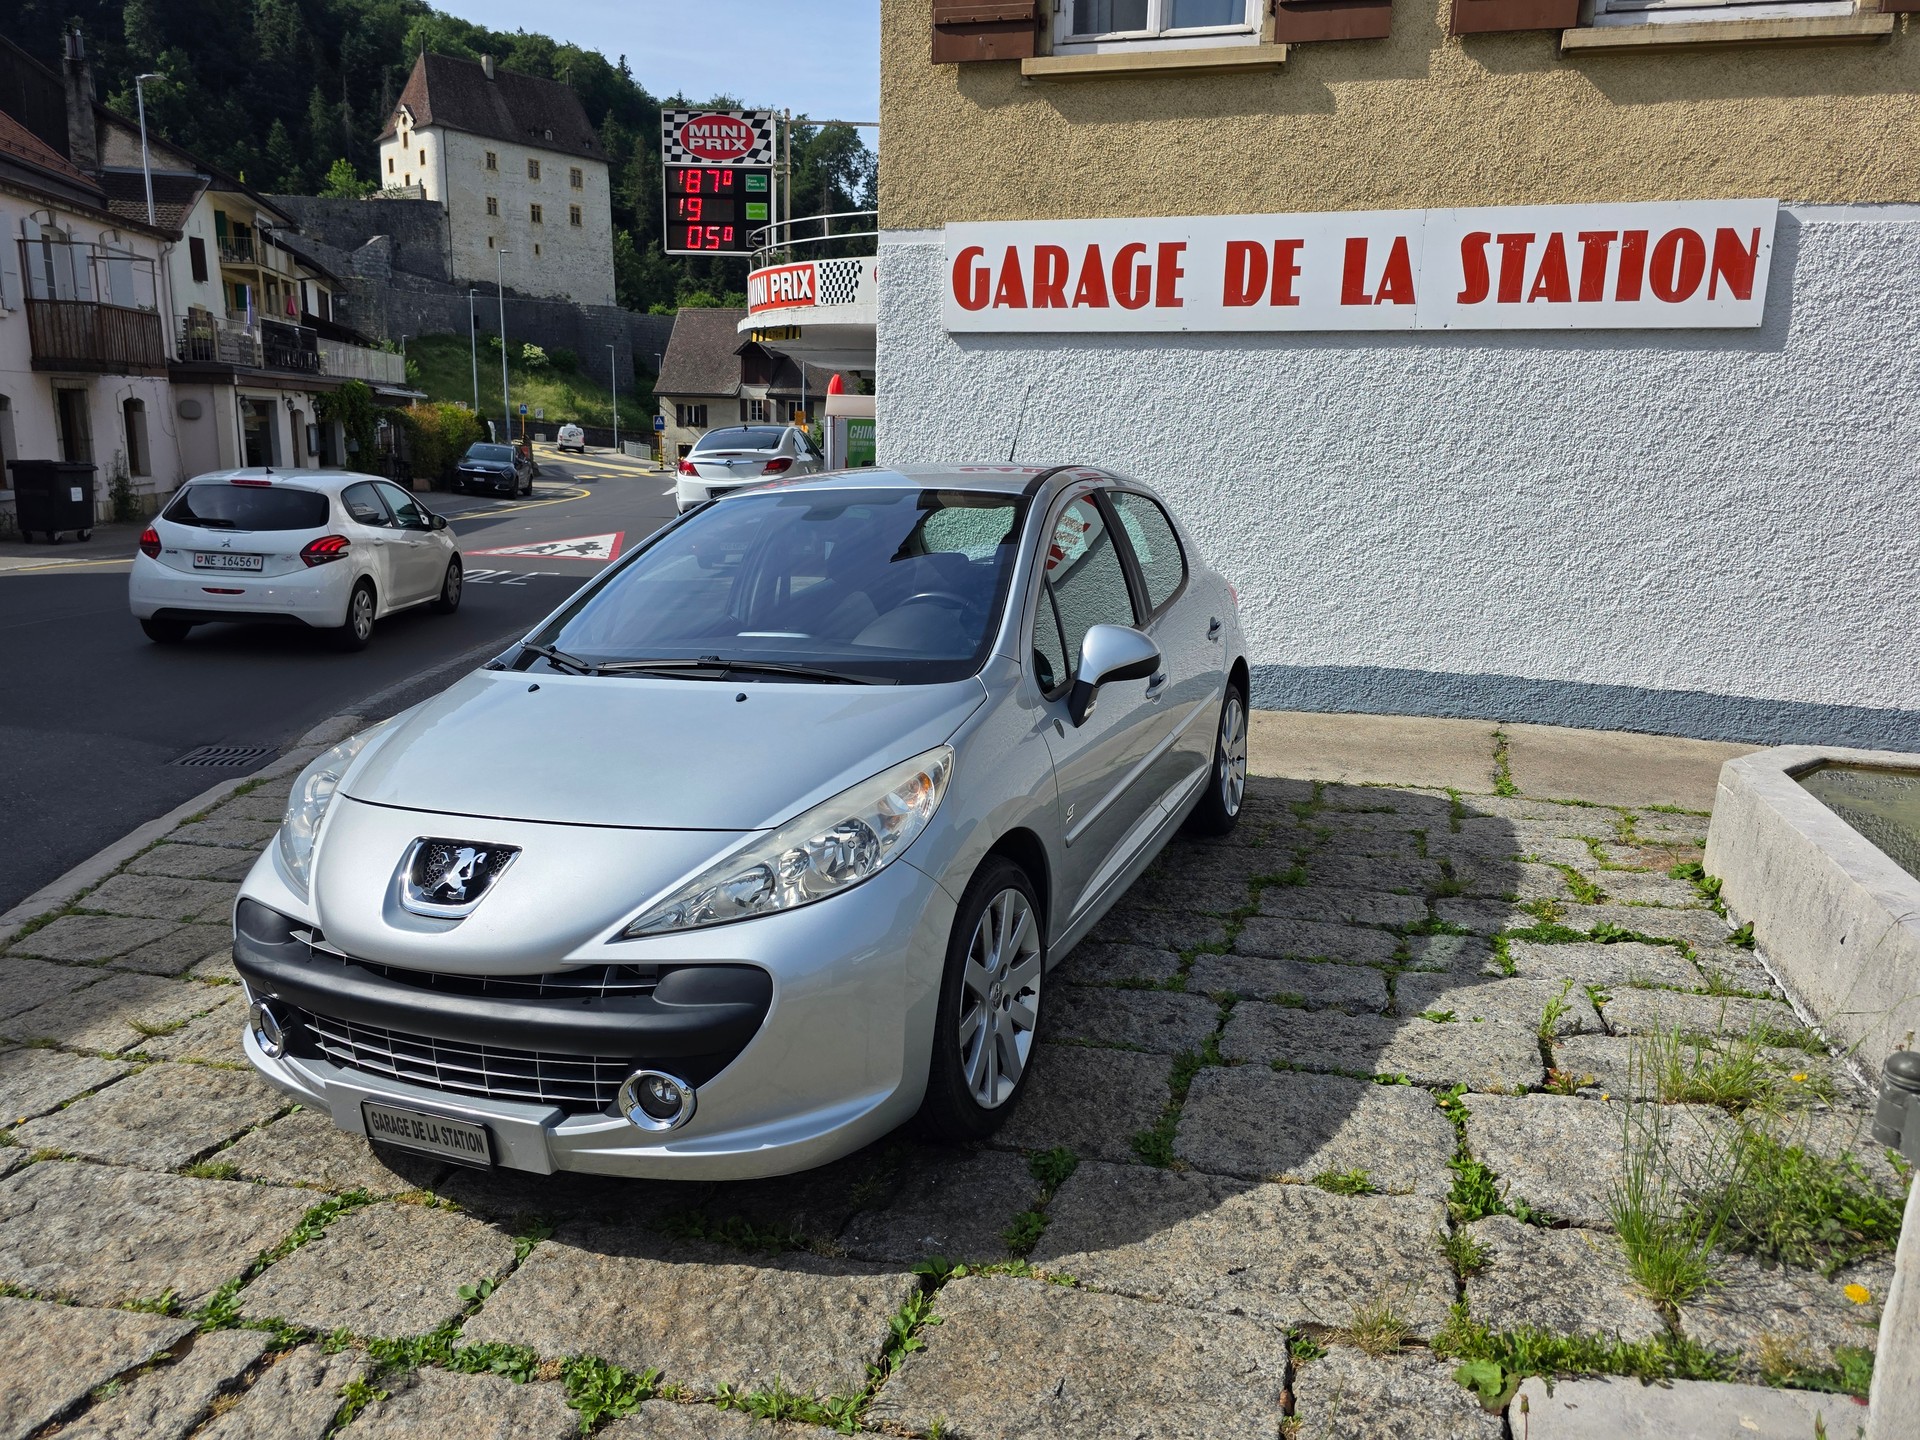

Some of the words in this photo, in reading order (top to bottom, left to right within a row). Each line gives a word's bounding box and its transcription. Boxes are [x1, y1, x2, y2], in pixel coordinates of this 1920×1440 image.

[688, 124, 747, 138] MINI
[688, 138, 748, 151] PRIX
[952, 243, 1186, 311] GARAGE
[1224, 240, 1303, 306] DE
[1342, 238, 1414, 305] LA
[1457, 228, 1759, 303] STATION
[750, 275, 768, 308] MINI
[770, 269, 813, 304] PRIX
[222, 556, 252, 567] 16456
[371, 1111, 412, 1137] GARAGE
[410, 1120, 426, 1141] DE
[426, 1123, 441, 1144] LA
[440, 1126, 485, 1154] STATION
